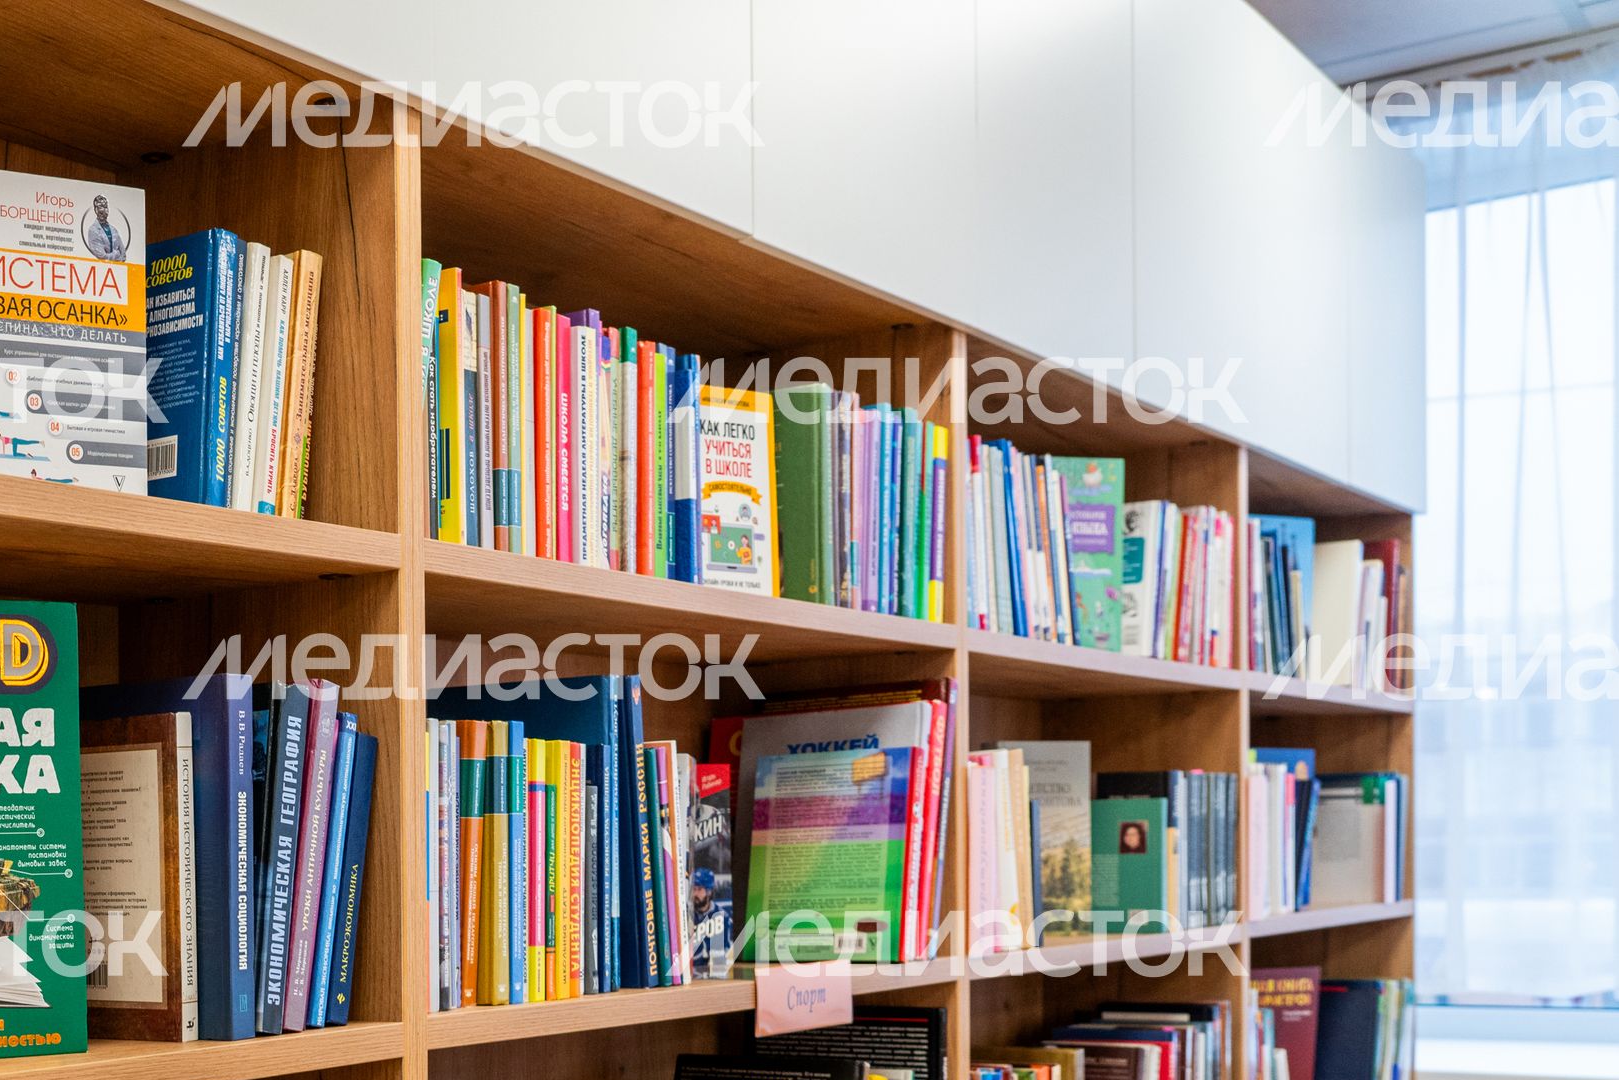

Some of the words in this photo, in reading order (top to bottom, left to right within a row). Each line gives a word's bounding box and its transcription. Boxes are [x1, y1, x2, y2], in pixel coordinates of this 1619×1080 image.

[36, 192, 74, 208] Игорь
[0, 204, 74, 225] БОРЩЕНКО
[151, 253, 186, 271] 10000
[38, 302, 128, 326] ОСАНКА»
[50, 323, 75, 338] ЧТО
[80, 327, 128, 343] ДЕЛАТЬ
[560, 393, 568, 445] ШКОЛА
[700, 420, 720, 435] КАК
[723, 424, 756, 441] ЛЕГКО
[71, 446, 81, 459] 05
[704, 442, 752, 459] УЧИТЬСЯ
[560, 448, 569, 512] СМЕЕТСЯ
[705, 459, 713, 473] В
[718, 460, 752, 478] ШКОЛЕ
[636, 743, 648, 814] РОССИИ
[38, 843, 67, 852] системы
[238, 791, 248, 892] ЭКОНОМИЧЕСКАЯ
[641, 822, 652, 882] МАРКИ
[268, 836, 292, 1005] ЭКОНОМИЧЕСКАЯ
[280, 715, 302, 824] ГЕОГРАФИЯ
[238, 894, 248, 971] СОЦИОЛОГИЯ
[340, 864, 359, 983] МАКРОЭКОНОМИКА
[643, 888, 658, 977] ПОЧТОВЫЕ
[787, 986, 827, 1011] Спорт
